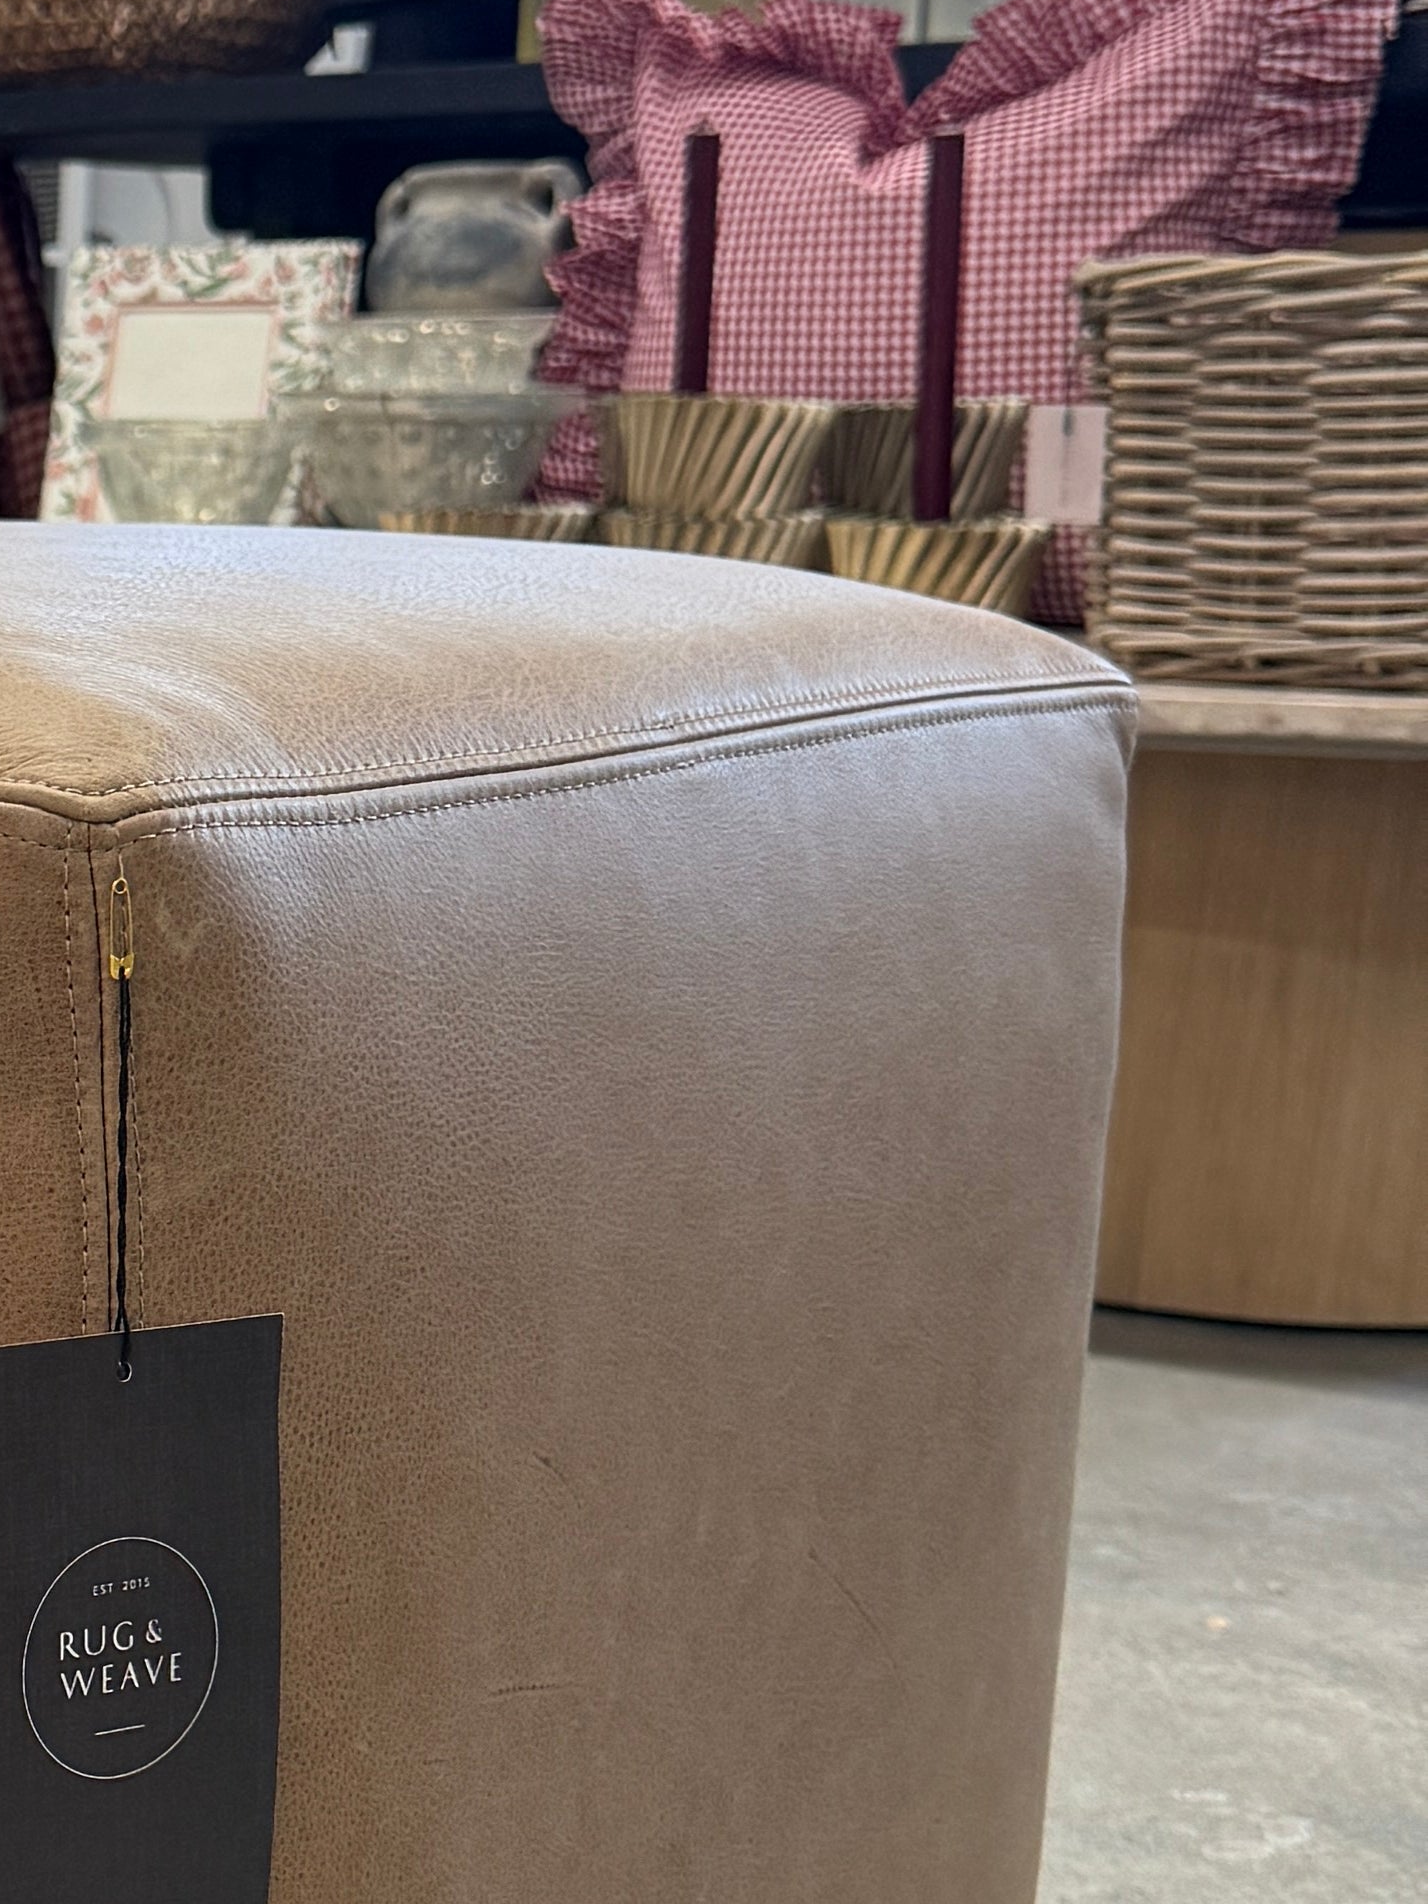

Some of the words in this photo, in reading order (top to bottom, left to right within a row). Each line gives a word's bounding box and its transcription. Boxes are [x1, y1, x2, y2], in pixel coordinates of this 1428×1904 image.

[93, 1583, 114, 1596] EST
[122, 1577, 150, 1591] 2015
[60, 1621, 134, 1661] RUG
[60, 1652, 182, 1699] WEAVE
